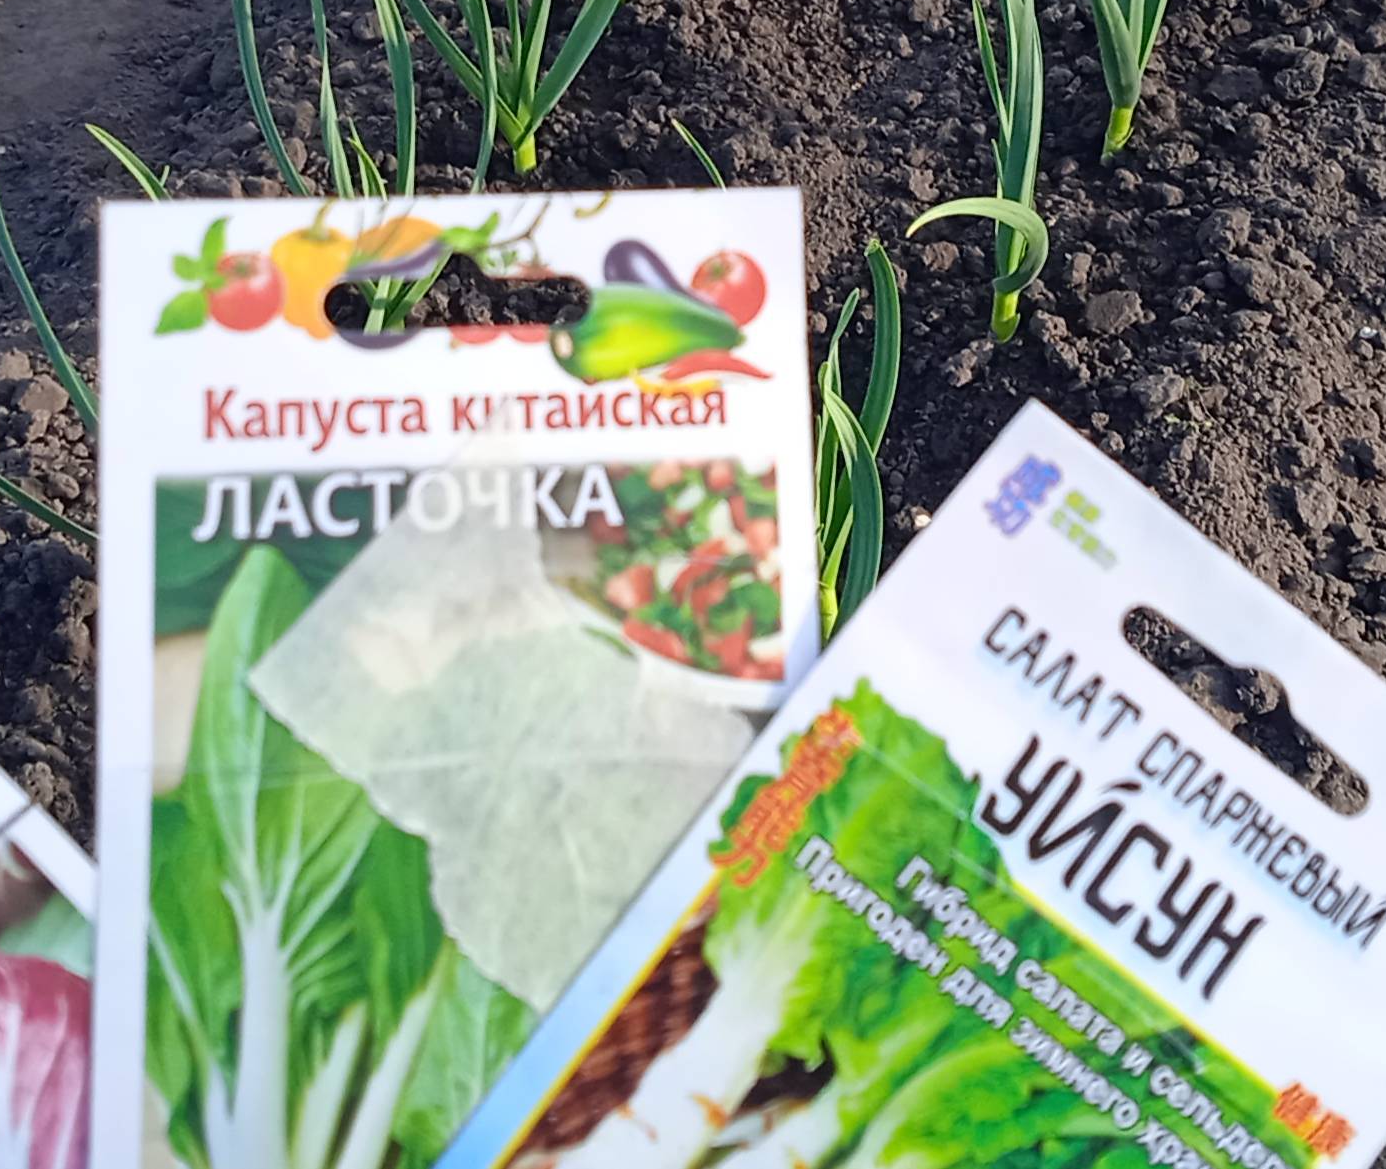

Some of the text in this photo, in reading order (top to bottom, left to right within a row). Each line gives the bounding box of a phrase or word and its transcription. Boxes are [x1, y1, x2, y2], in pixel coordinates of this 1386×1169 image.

[193, 464, 625, 541] ЛАСТОЧКА
[202, 388, 428, 451] Капуста
[982, 605, 1143, 739] САЛАТ
[980, 735, 1266, 1001] УЙСУН
[795, 835, 1213, 1169] Пригоден для зимнего хра
[896, 855, 1018, 977] Гибрид
[1014, 959, 1126, 1057] салата
[1121, 1042, 1154, 1077] и
